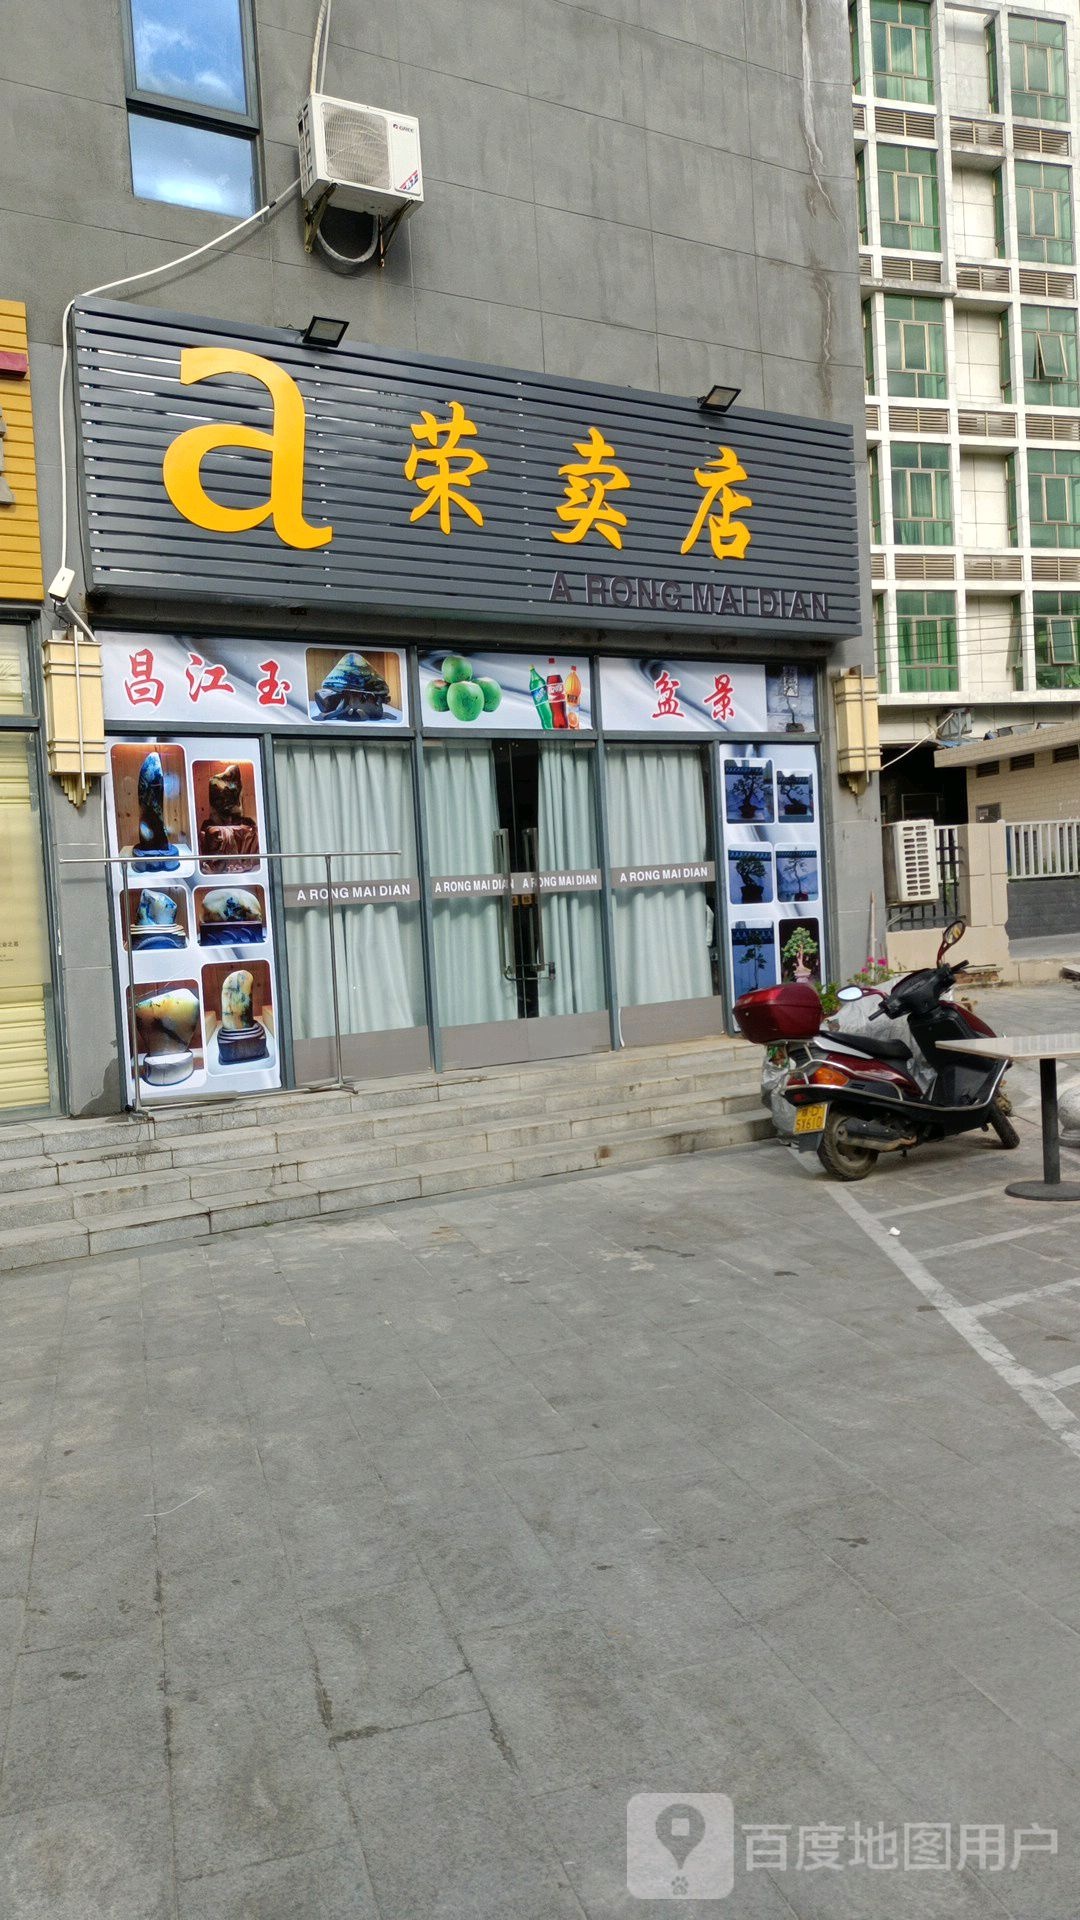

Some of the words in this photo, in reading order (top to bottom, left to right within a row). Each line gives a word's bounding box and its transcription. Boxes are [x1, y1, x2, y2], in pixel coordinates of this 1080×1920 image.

[161, 346, 333, 550] a
[403, 400, 753, 560] 荣卖店
[548, 571, 573, 603] A
[584, 573, 683, 612] RONG
[691, 581, 749, 616] MAI
[758, 587, 831, 621] DIAN
[123, 647, 293, 708] 昌江玉
[651, 670, 737, 723] 盆景
[297, 889, 306, 901] A
[310, 887, 349, 900] RONG
[352, 886, 376, 898] MAI
[379, 884, 411, 897] DIAN
[435, 882, 442, 893] A
[443, 880, 471, 892] RONG
[473, 879, 490, 891] MAI
[522, 877, 529, 888] A
[558, 875, 575, 886] MAI
[576, 874, 597, 886] DIAN
[620, 872, 627, 883] A
[629, 870, 660, 882] RONG
[662, 869, 681, 879] MAI
[683, 867, 708, 878] DIAN
